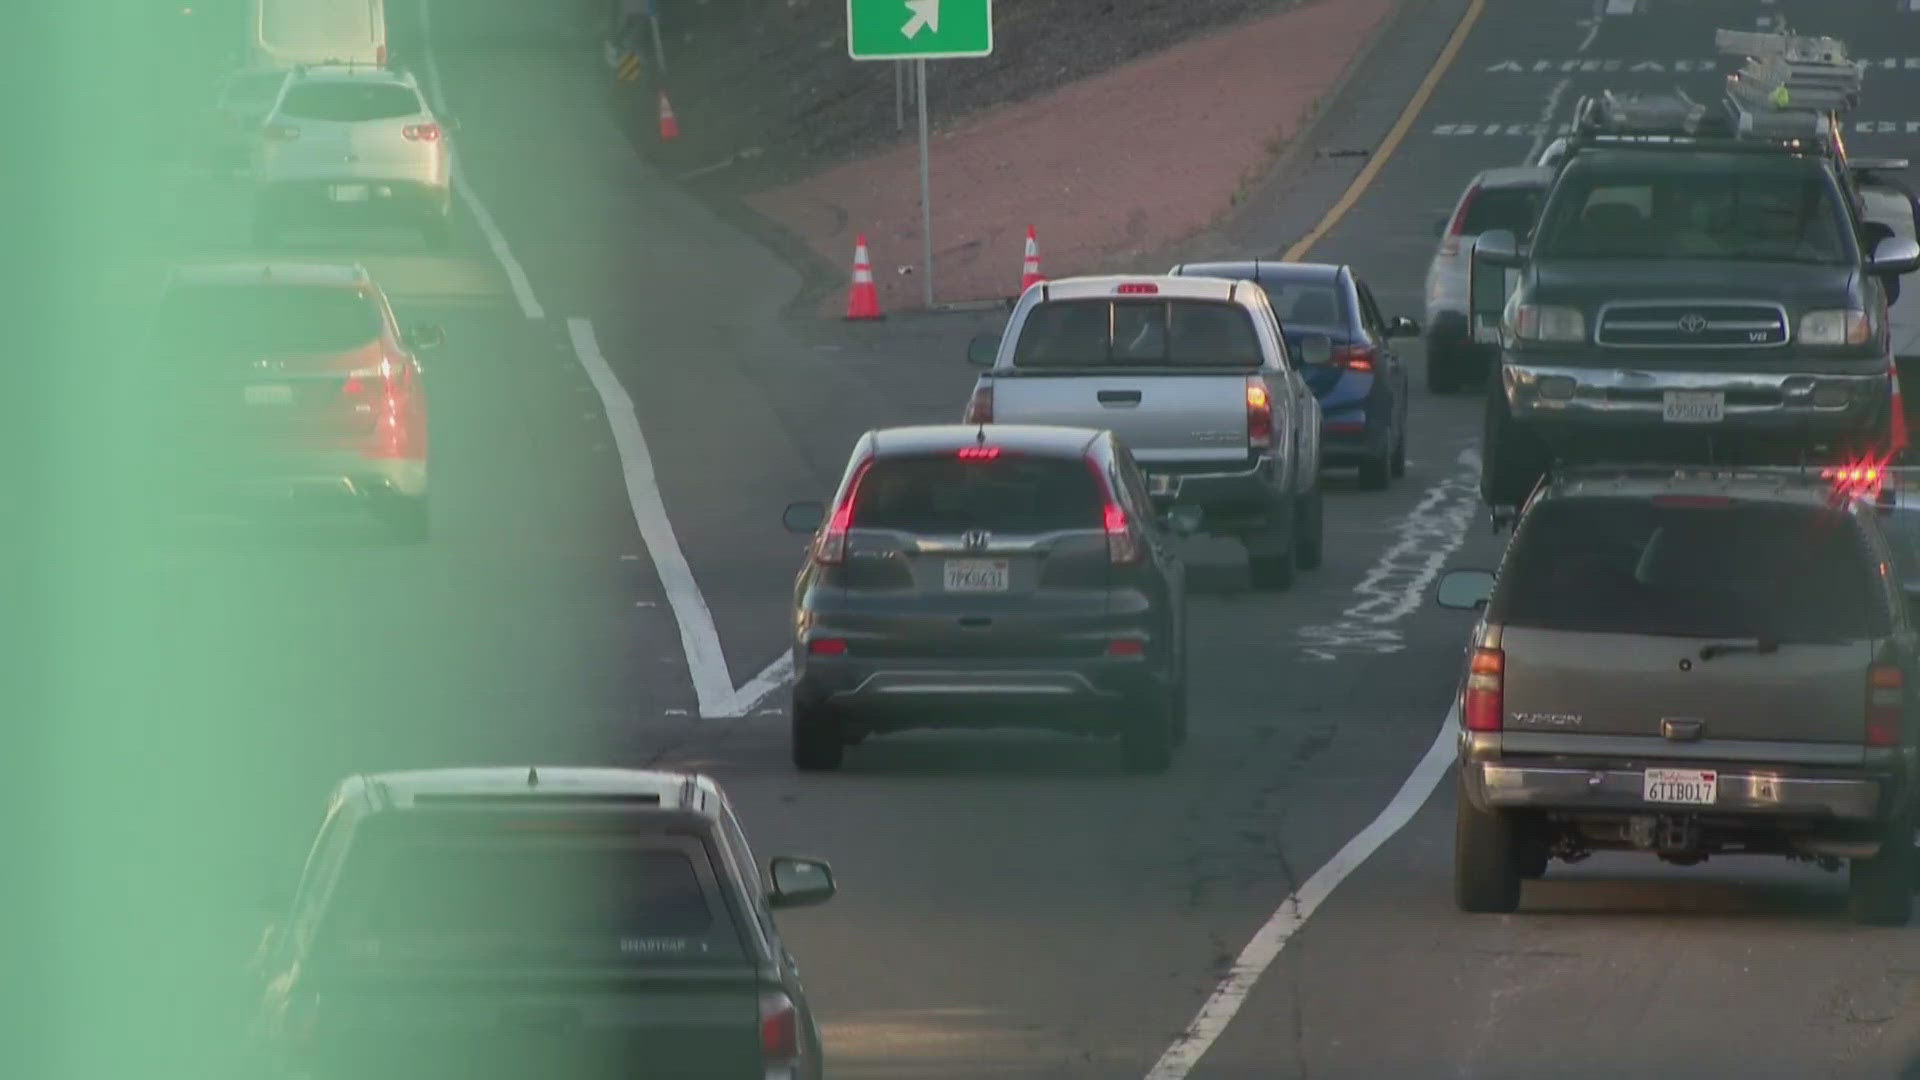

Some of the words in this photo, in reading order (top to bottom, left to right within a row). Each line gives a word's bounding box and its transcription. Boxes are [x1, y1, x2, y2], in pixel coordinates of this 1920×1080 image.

[1749, 331, 1768, 342] V8
[1512, 712, 1583, 725] YUKON
[1649, 782, 1712, 801] 6TIB017
